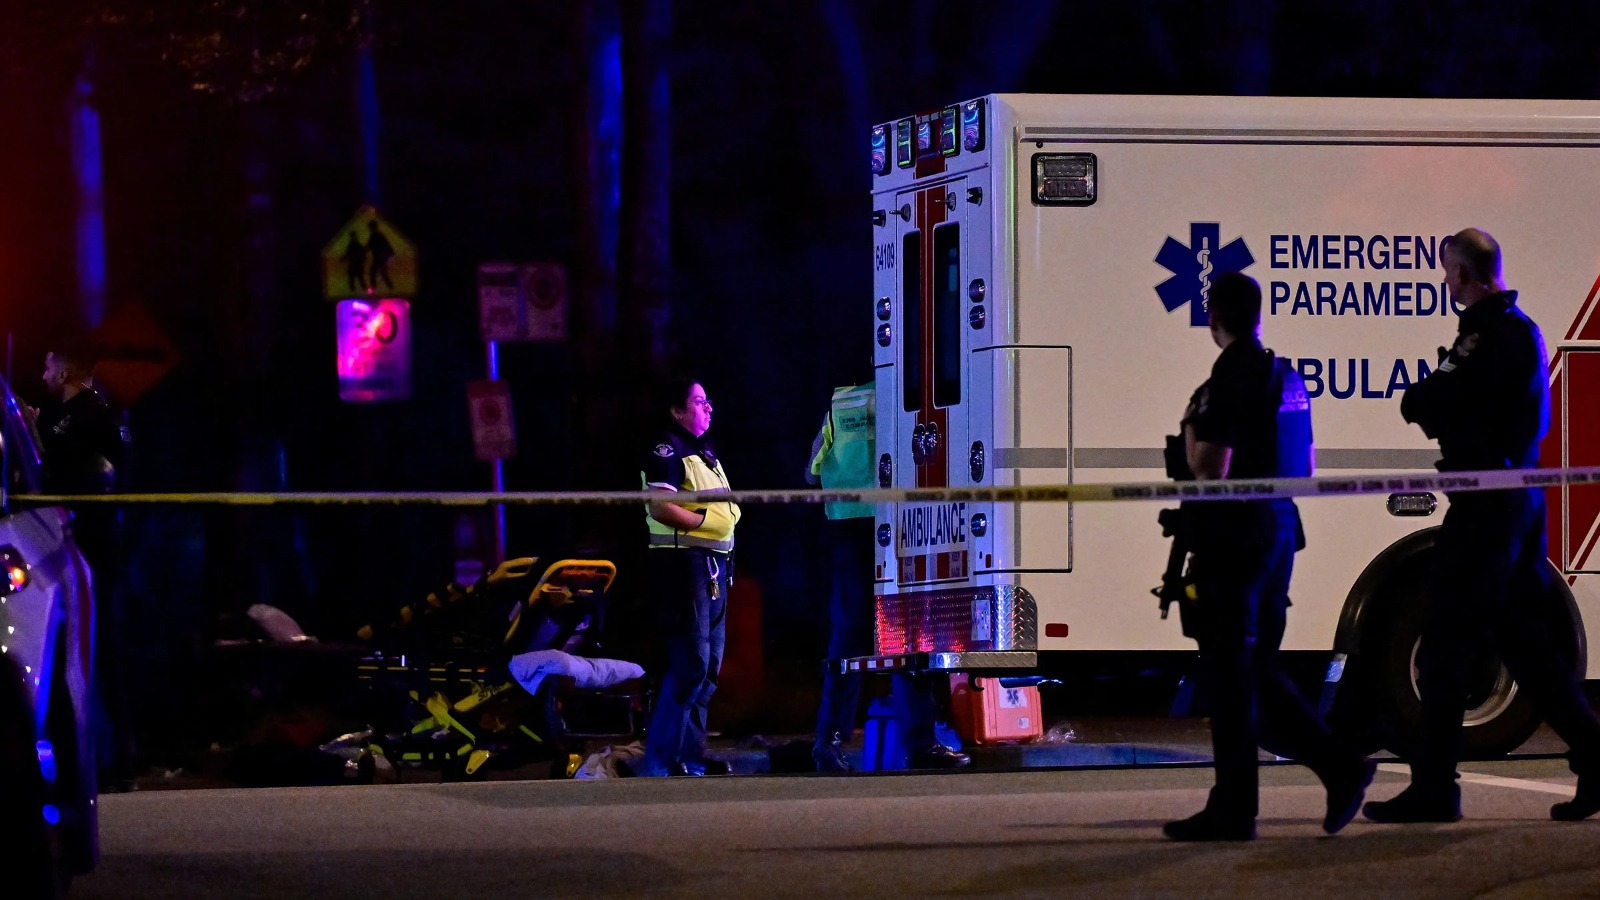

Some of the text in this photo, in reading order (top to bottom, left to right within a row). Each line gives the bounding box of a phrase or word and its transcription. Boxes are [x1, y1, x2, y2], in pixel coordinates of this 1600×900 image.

[876, 242, 895, 272] 64109
[1270, 234, 1456, 270] EMERGEN
[1285, 358, 1440, 400] BULAN
[900, 502, 966, 549] AMBULANCE
